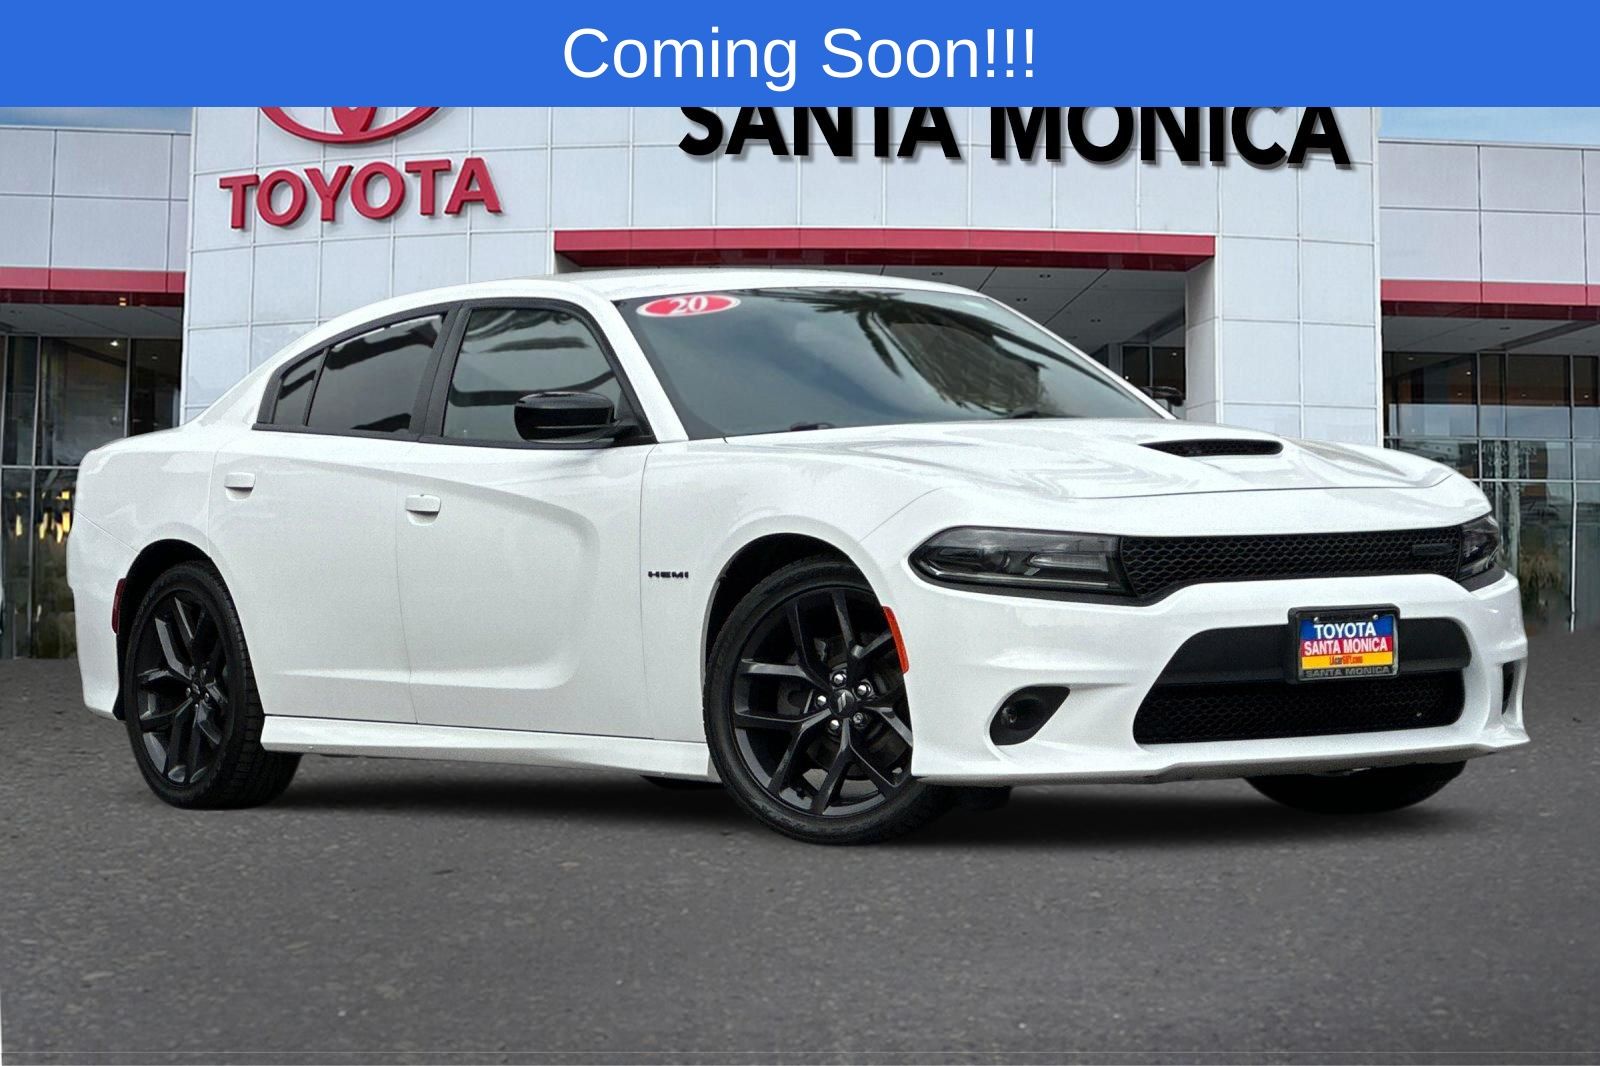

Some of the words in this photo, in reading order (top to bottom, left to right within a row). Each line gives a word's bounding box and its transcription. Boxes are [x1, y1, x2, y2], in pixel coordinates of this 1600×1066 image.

[990, 107, 1351, 166] MONICA
[219, 157, 503, 229] TOYOTA
[668, 296, 709, 314] 20
[648, 571, 689, 579] HEMI
[1313, 622, 1377, 639] TOYOTA
[1303, 640, 1341, 656] SANTA
[1343, 637, 1388, 654] MONICA
[1306, 668, 1343, 678] SANTA
[1345, 666, 1390, 676] MONICA
